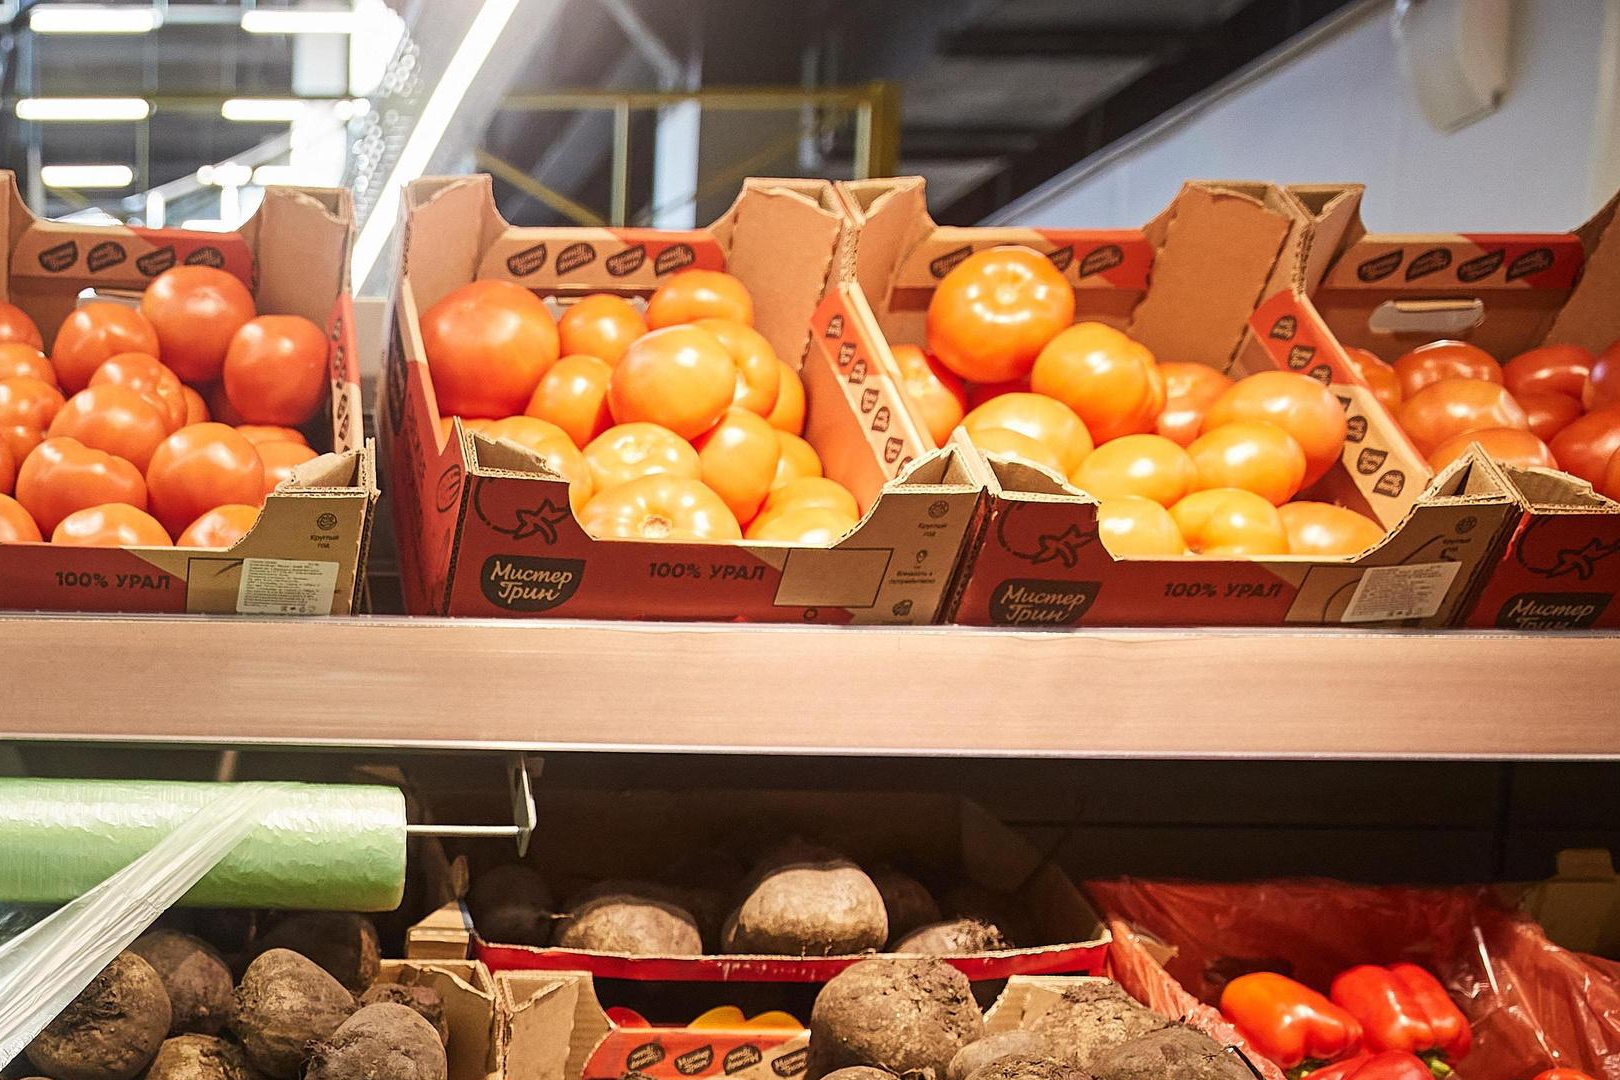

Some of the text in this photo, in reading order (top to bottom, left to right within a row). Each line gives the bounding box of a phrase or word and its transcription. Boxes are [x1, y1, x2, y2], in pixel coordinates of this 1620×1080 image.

[55, 571, 170, 590] 100% УРАЛ
[490, 560, 573, 589] Мистер
[648, 562, 766, 581] 100% УРАЛ
[498, 581, 560, 604] Грин
[1000, 584, 1085, 610] Мистер
[1164, 583, 1283, 598] 100% УРАЛ
[1005, 604, 1070, 624] Грин
[1508, 599, 1595, 621] Мистер
